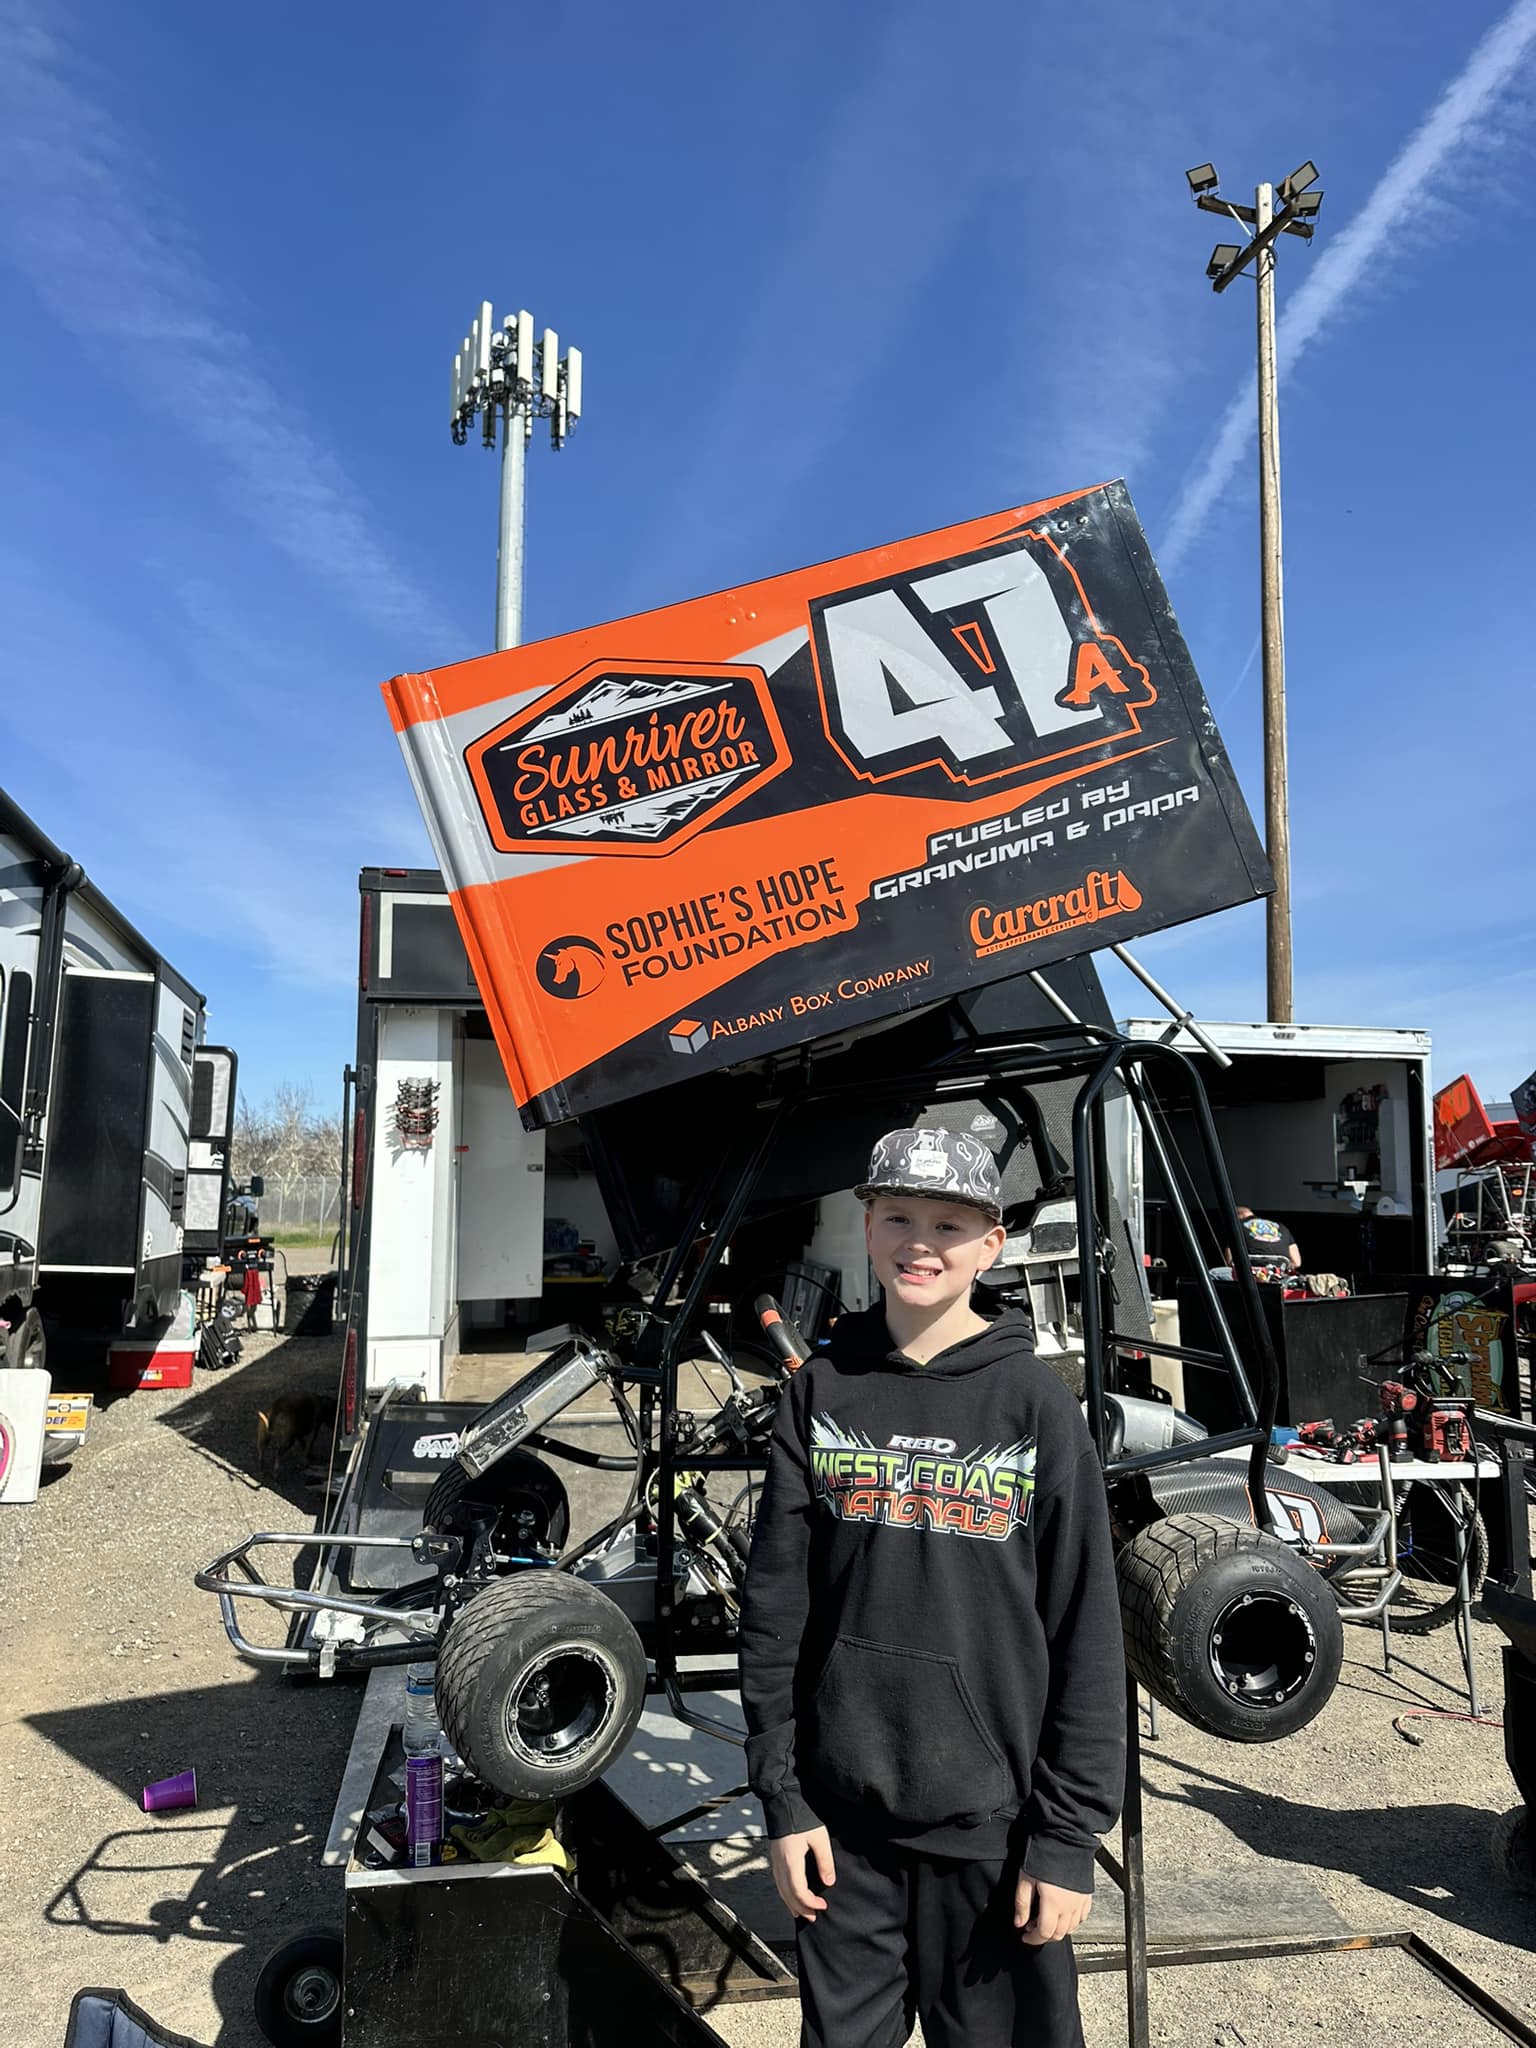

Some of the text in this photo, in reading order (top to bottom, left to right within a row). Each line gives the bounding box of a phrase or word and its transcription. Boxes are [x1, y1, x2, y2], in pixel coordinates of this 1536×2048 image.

[823, 549, 1104, 763] 47
[512, 699, 747, 802] Sunriver
[519, 740, 760, 827] GLASS & MIRROR
[873, 785, 1200, 901] GRANDMA & PAPA
[930, 779, 1132, 856] FUELED BY
[605, 857, 845, 960] SOPHIE'S HOPE
[621, 898, 848, 987] FOUNDATION
[969, 870, 1118, 947] Carcraft
[985, 919, 1077, 953] AUTO APPEARANCE CENTER
[812, 1451, 1035, 1518] WEST COAST
[835, 1489, 1009, 1536] NATIONALS
